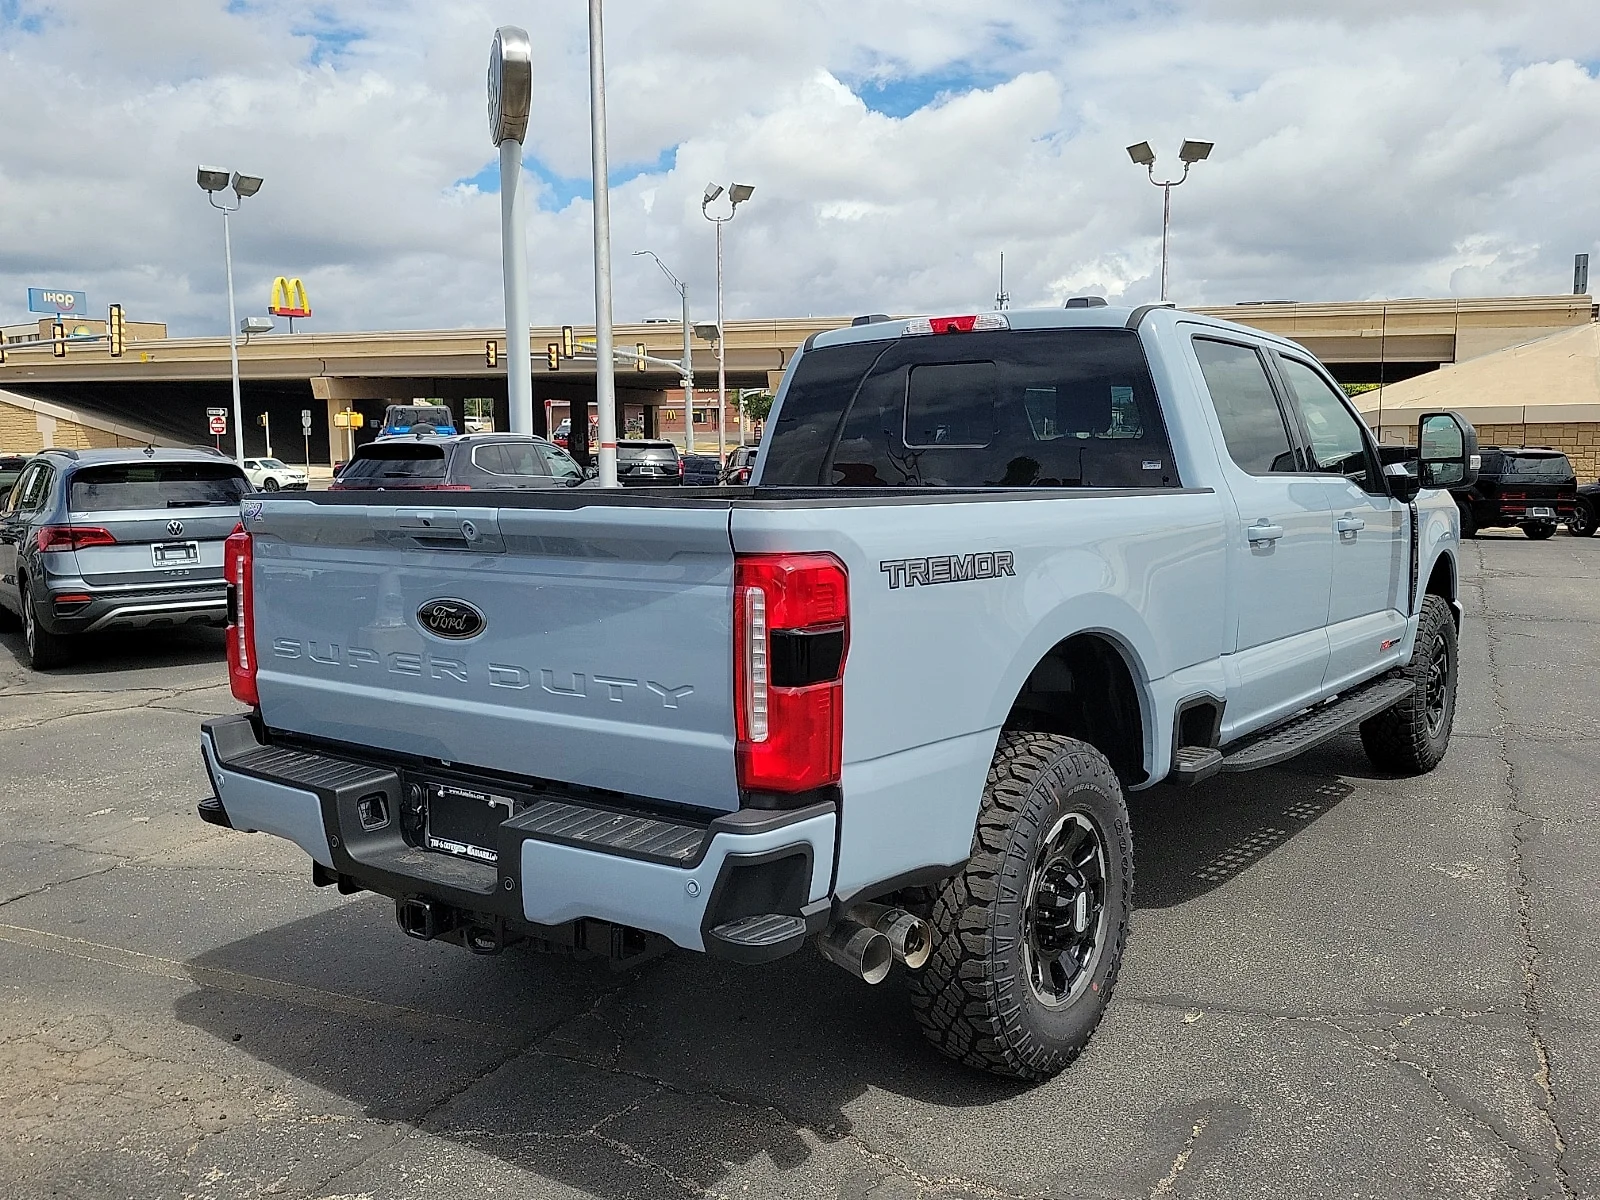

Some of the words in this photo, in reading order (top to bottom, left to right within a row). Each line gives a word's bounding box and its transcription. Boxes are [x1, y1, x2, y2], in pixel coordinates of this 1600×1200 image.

[879, 551, 1016, 589] TREMOR
[429, 605, 467, 631] Ford
[272, 636, 468, 683] SUPER
[488, 662, 694, 709] DUTY
